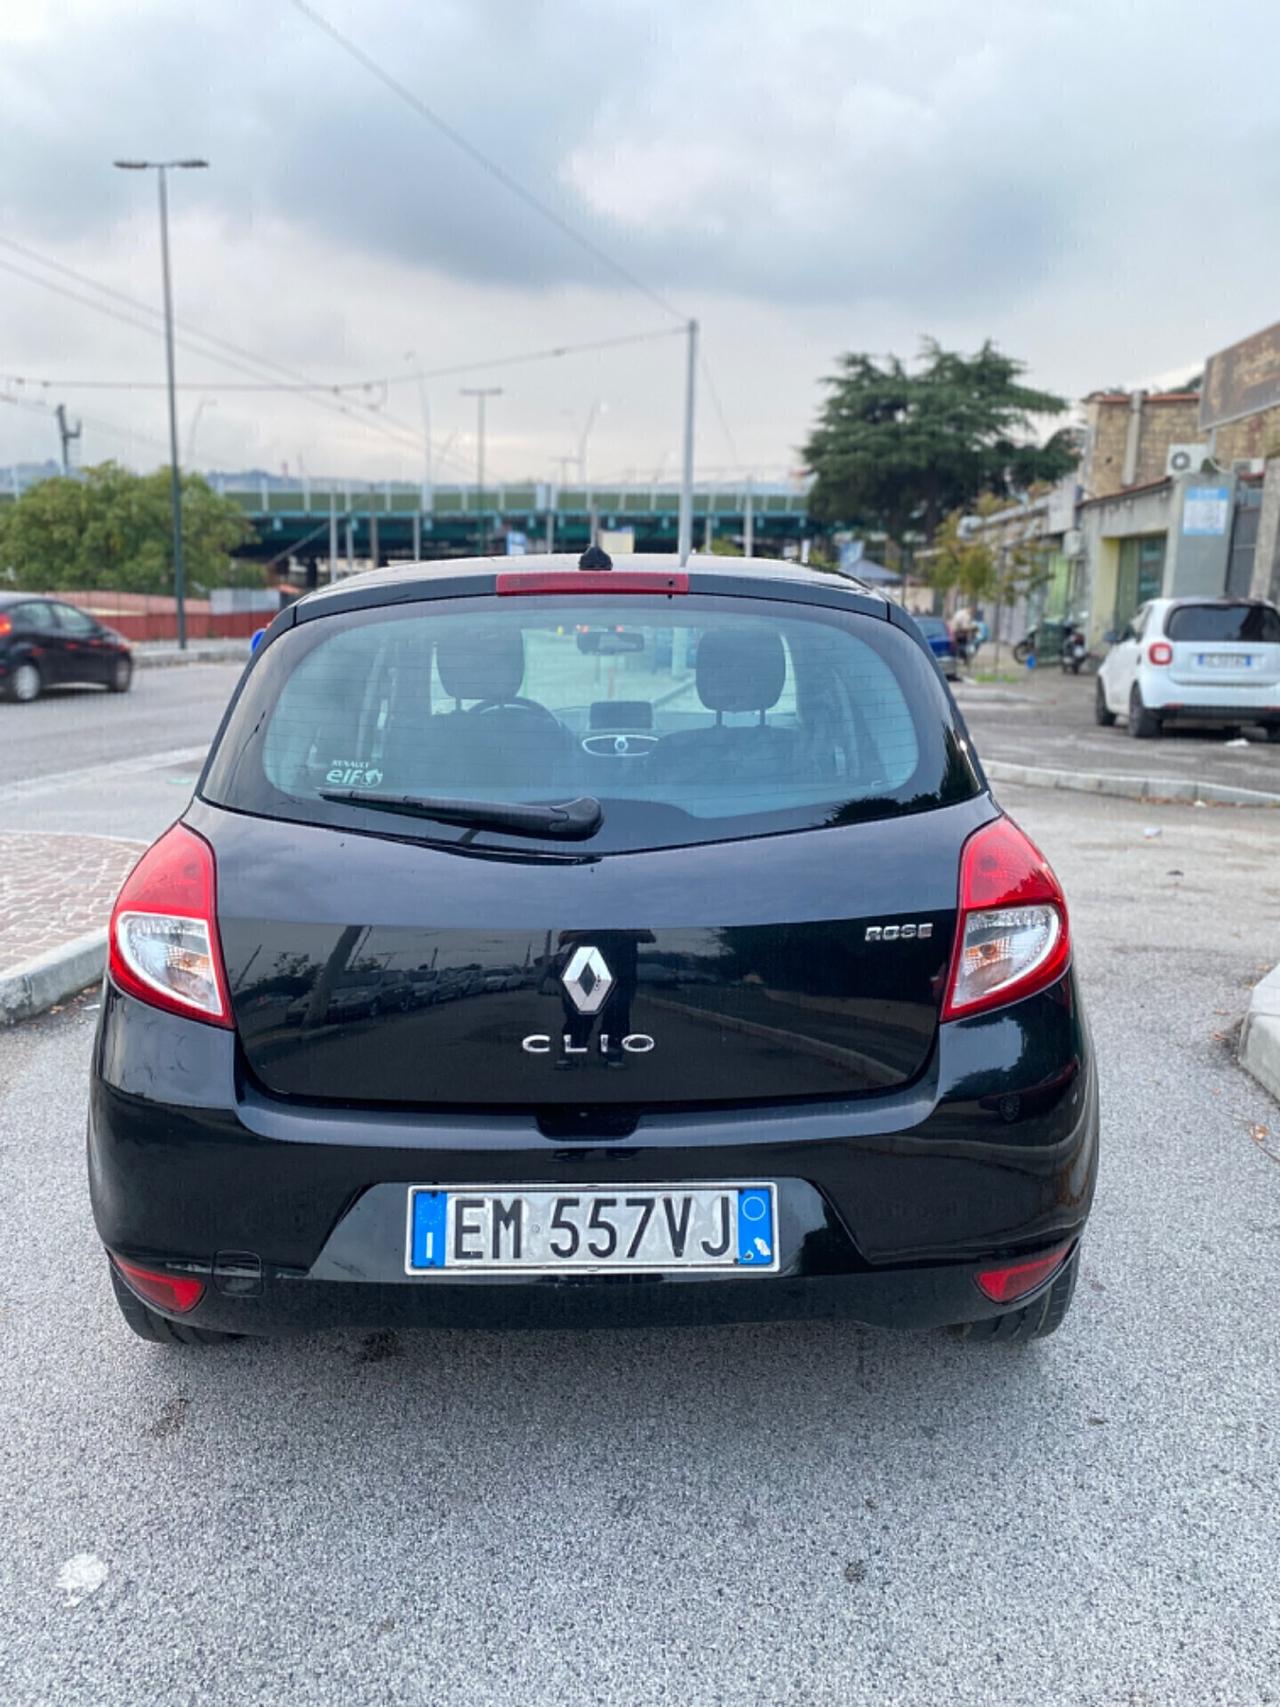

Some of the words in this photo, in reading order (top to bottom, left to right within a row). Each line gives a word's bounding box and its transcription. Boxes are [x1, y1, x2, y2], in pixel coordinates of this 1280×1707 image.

[326, 768, 363, 784] elf
[865, 923, 933, 941] ROSE
[522, 1034, 654, 1053] CLIO
[454, 1198, 523, 1260] EM
[549, 1196, 731, 1259] 557VJ
